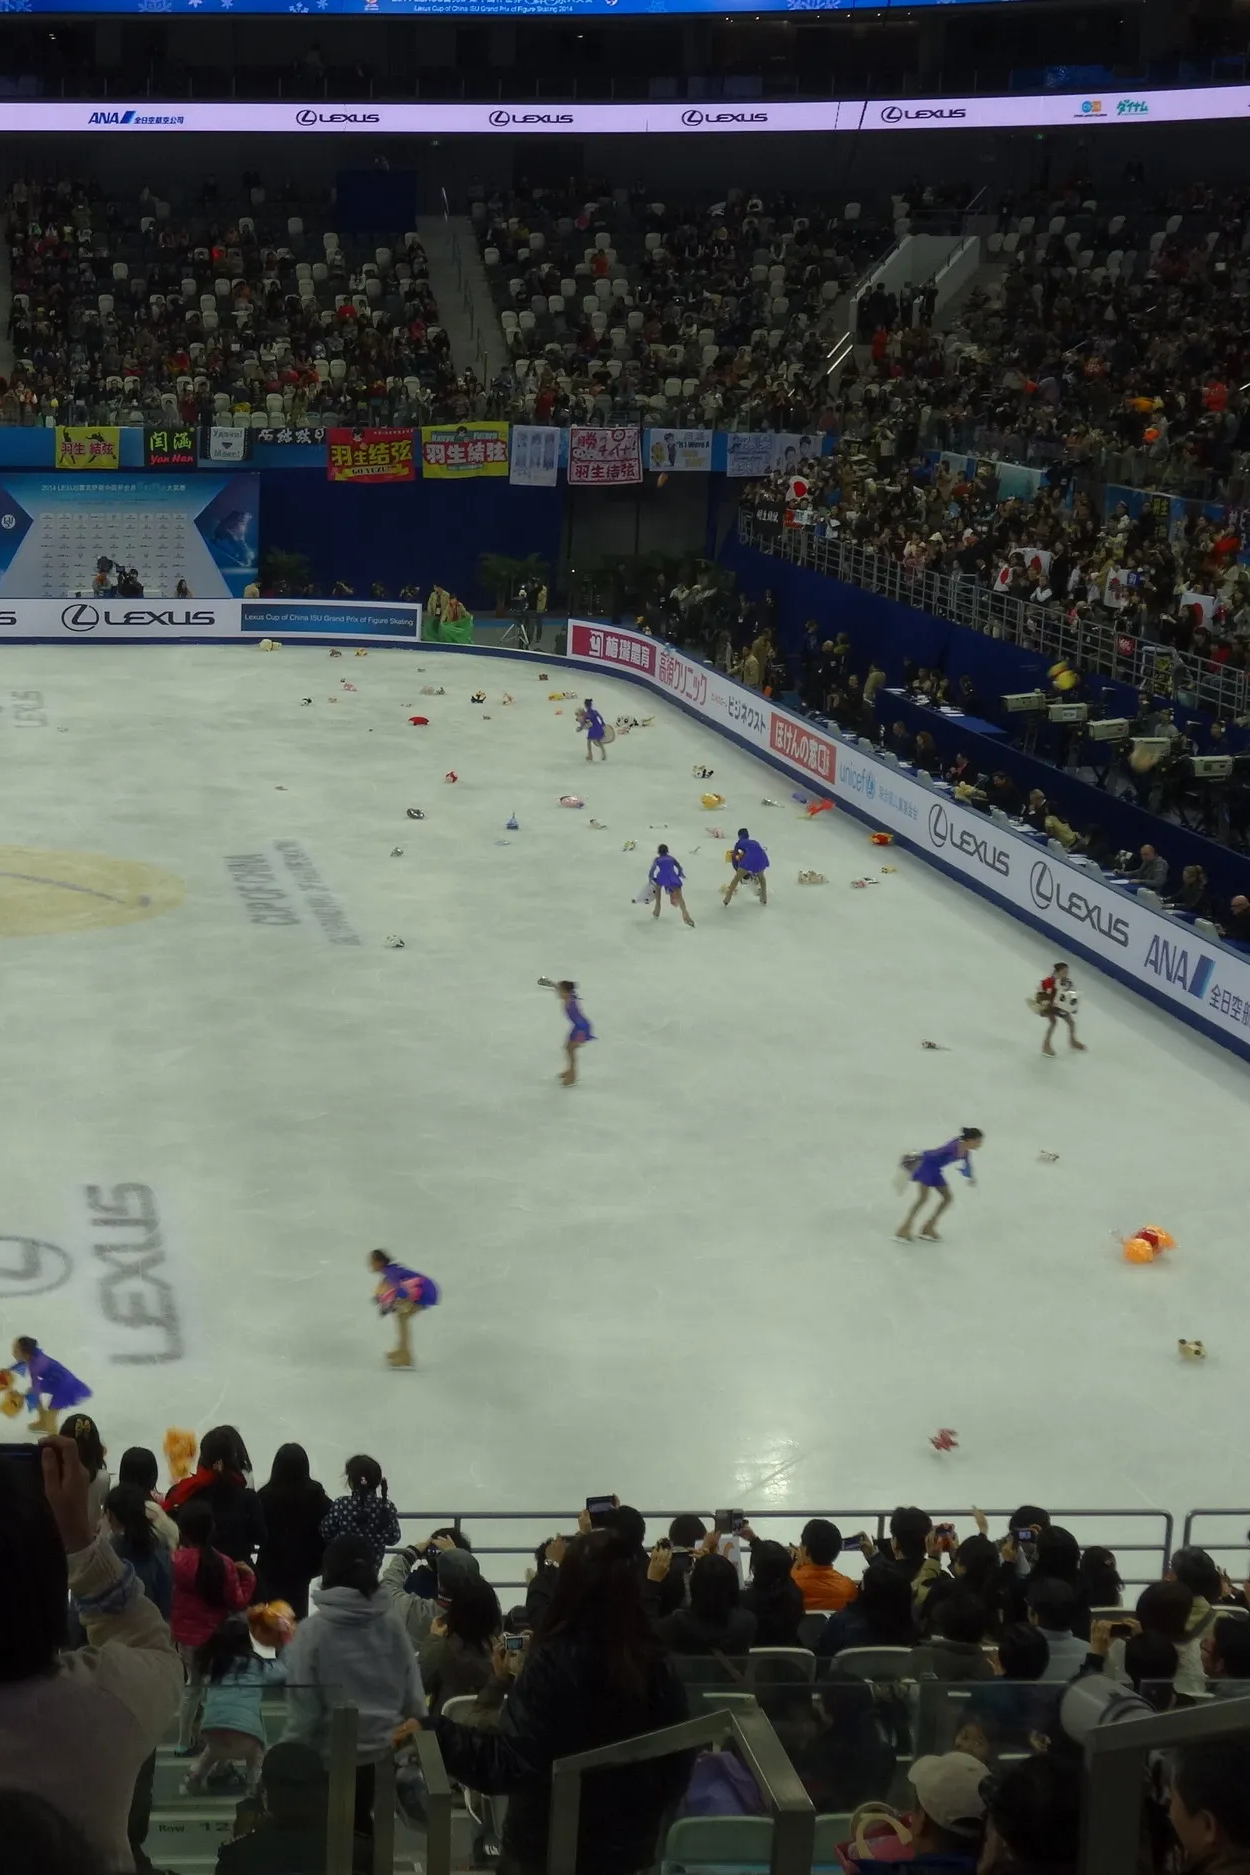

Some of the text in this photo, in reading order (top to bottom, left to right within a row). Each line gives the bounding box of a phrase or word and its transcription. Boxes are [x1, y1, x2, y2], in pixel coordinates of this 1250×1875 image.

[88, 112, 119, 124] ANA
[319, 113, 380, 123] LEXUS
[512, 114, 573, 124] LEXUS
[705, 113, 768, 123] LEXUS
[904, 108, 966, 119] LEXUS
[150, 453, 194, 466] Yan Han
[104, 610, 215, 625] LEXUS
[244, 613, 265, 621] Lexus
[265, 614, 281, 622] Cup
[281, 613, 290, 621] of
[289, 614, 309, 622] China
[310, 614, 323, 622] ISU
[323, 615, 345, 623] Grand
[367, 617, 389, 625] Figure
[390, 618, 414, 627] Skating
[728, 695, 767, 735] ビジネクスト
[775, 719, 827, 777] ほけんの窓口
[839, 761, 866, 792] unicef
[950, 823, 1010, 877] LEXUS
[1055, 883, 1130, 948] LEXUS
[1144, 934, 1188, 991] ANA
[86, 1181, 183, 1366] LEXUS
[159, 1821, 230, 1832] Row 12
